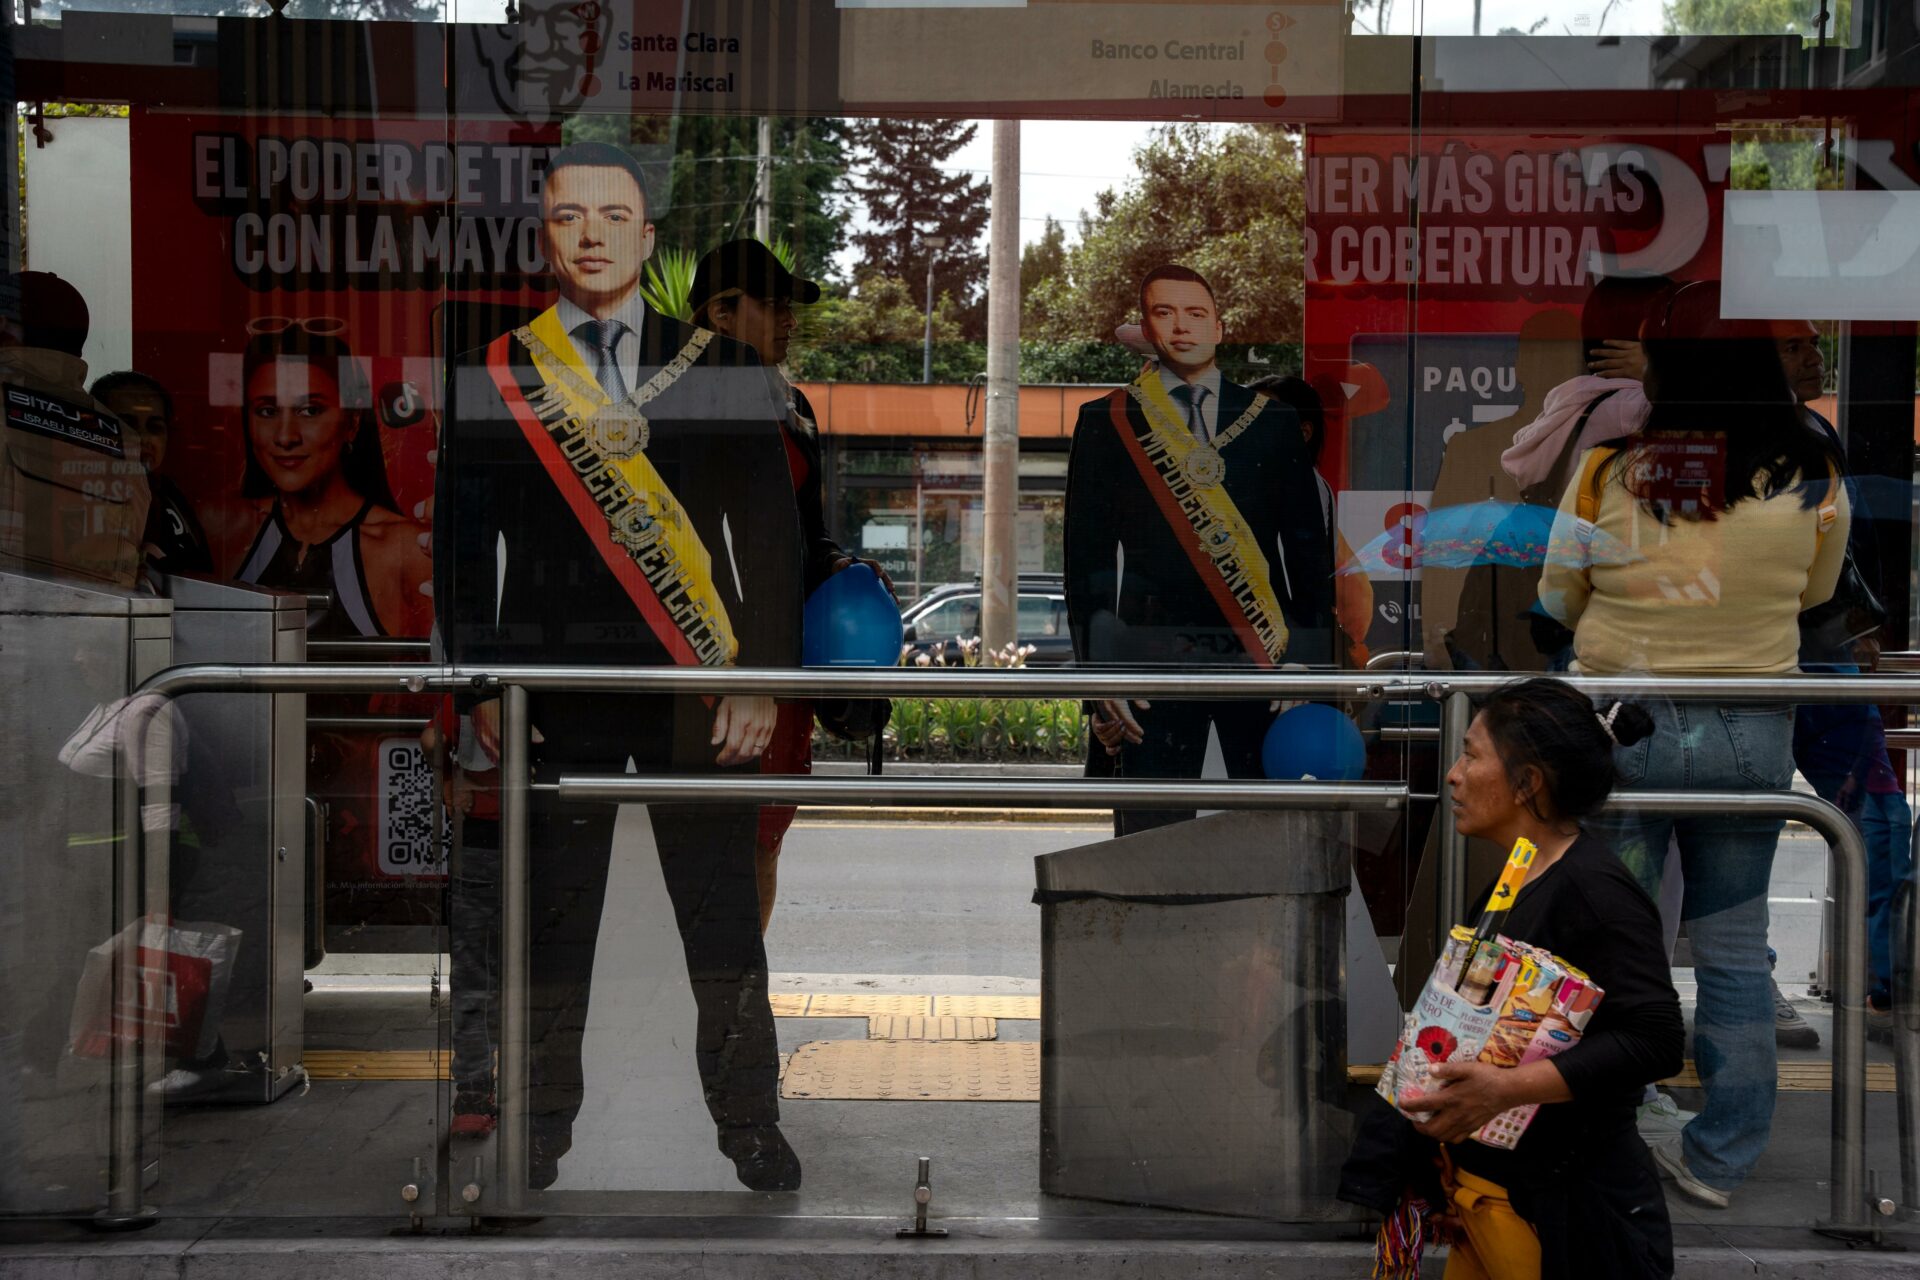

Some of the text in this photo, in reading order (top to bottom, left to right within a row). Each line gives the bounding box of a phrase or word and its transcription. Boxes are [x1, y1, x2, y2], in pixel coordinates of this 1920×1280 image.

[618, 32, 740, 53] Santa Clara
[1091, 39, 1244, 60] Banco Central
[618, 72, 733, 93] La Mariscal
[1149, 79, 1244, 100] Alameda
[195, 135, 558, 205] EL PODER DE TE
[1392, 144, 1493, 214] MÁS
[1504, 149, 1645, 214] GIGAS
[235, 212, 331, 274] CON
[345, 214, 402, 274] LA
[1330, 224, 1605, 287] COBERTURA
[68, 426, 119, 448] SECURITY
